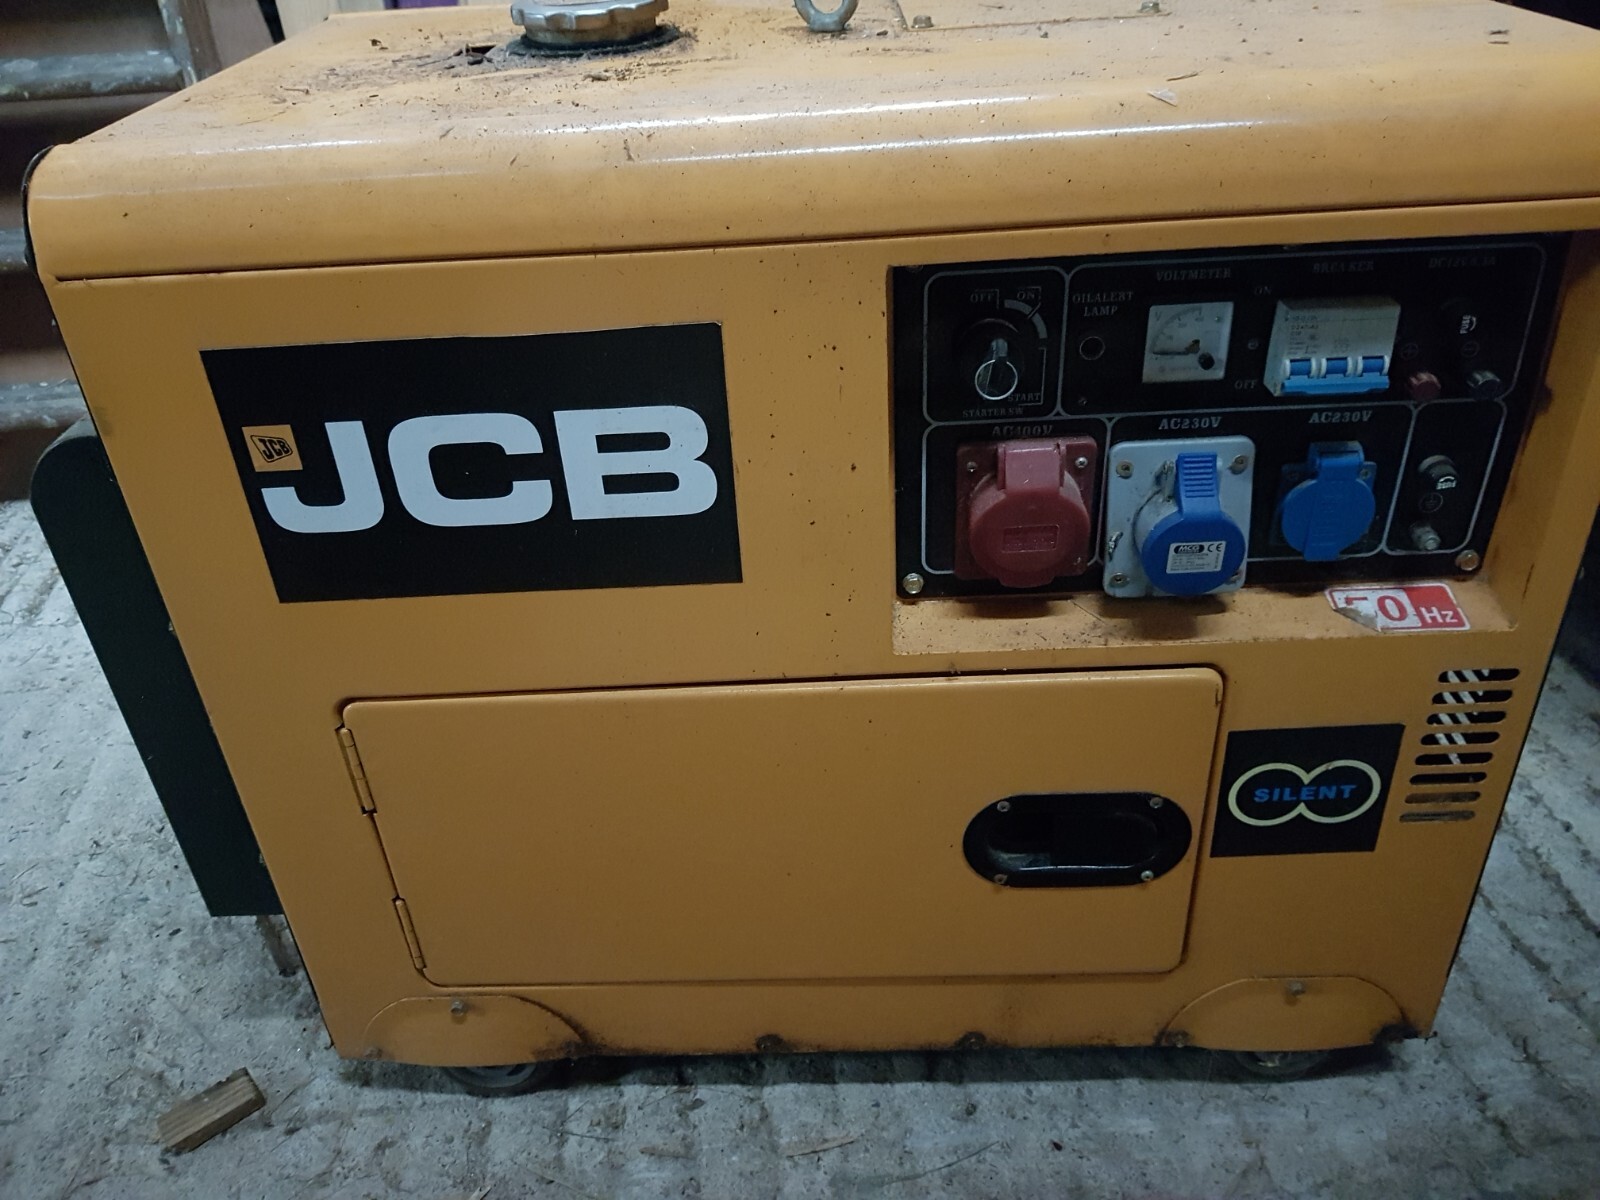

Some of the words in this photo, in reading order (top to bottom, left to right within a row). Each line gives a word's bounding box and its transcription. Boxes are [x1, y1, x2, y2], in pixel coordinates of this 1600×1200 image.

[1156, 268, 1232, 281] VOLTMETER
[1017, 290, 1036, 300] ON
[1083, 305, 1118, 317] LAMP
[1234, 379, 1258, 390] OFF
[962, 408, 1006, 418] STARTER
[1308, 410, 1374, 423] AC230V
[1158, 416, 1223, 430] AC230V
[257, 438, 290, 460] JCB
[261, 405, 719, 534] JCB
[1419, 606, 1459, 623] Hz
[1253, 784, 1359, 803] SILENT
